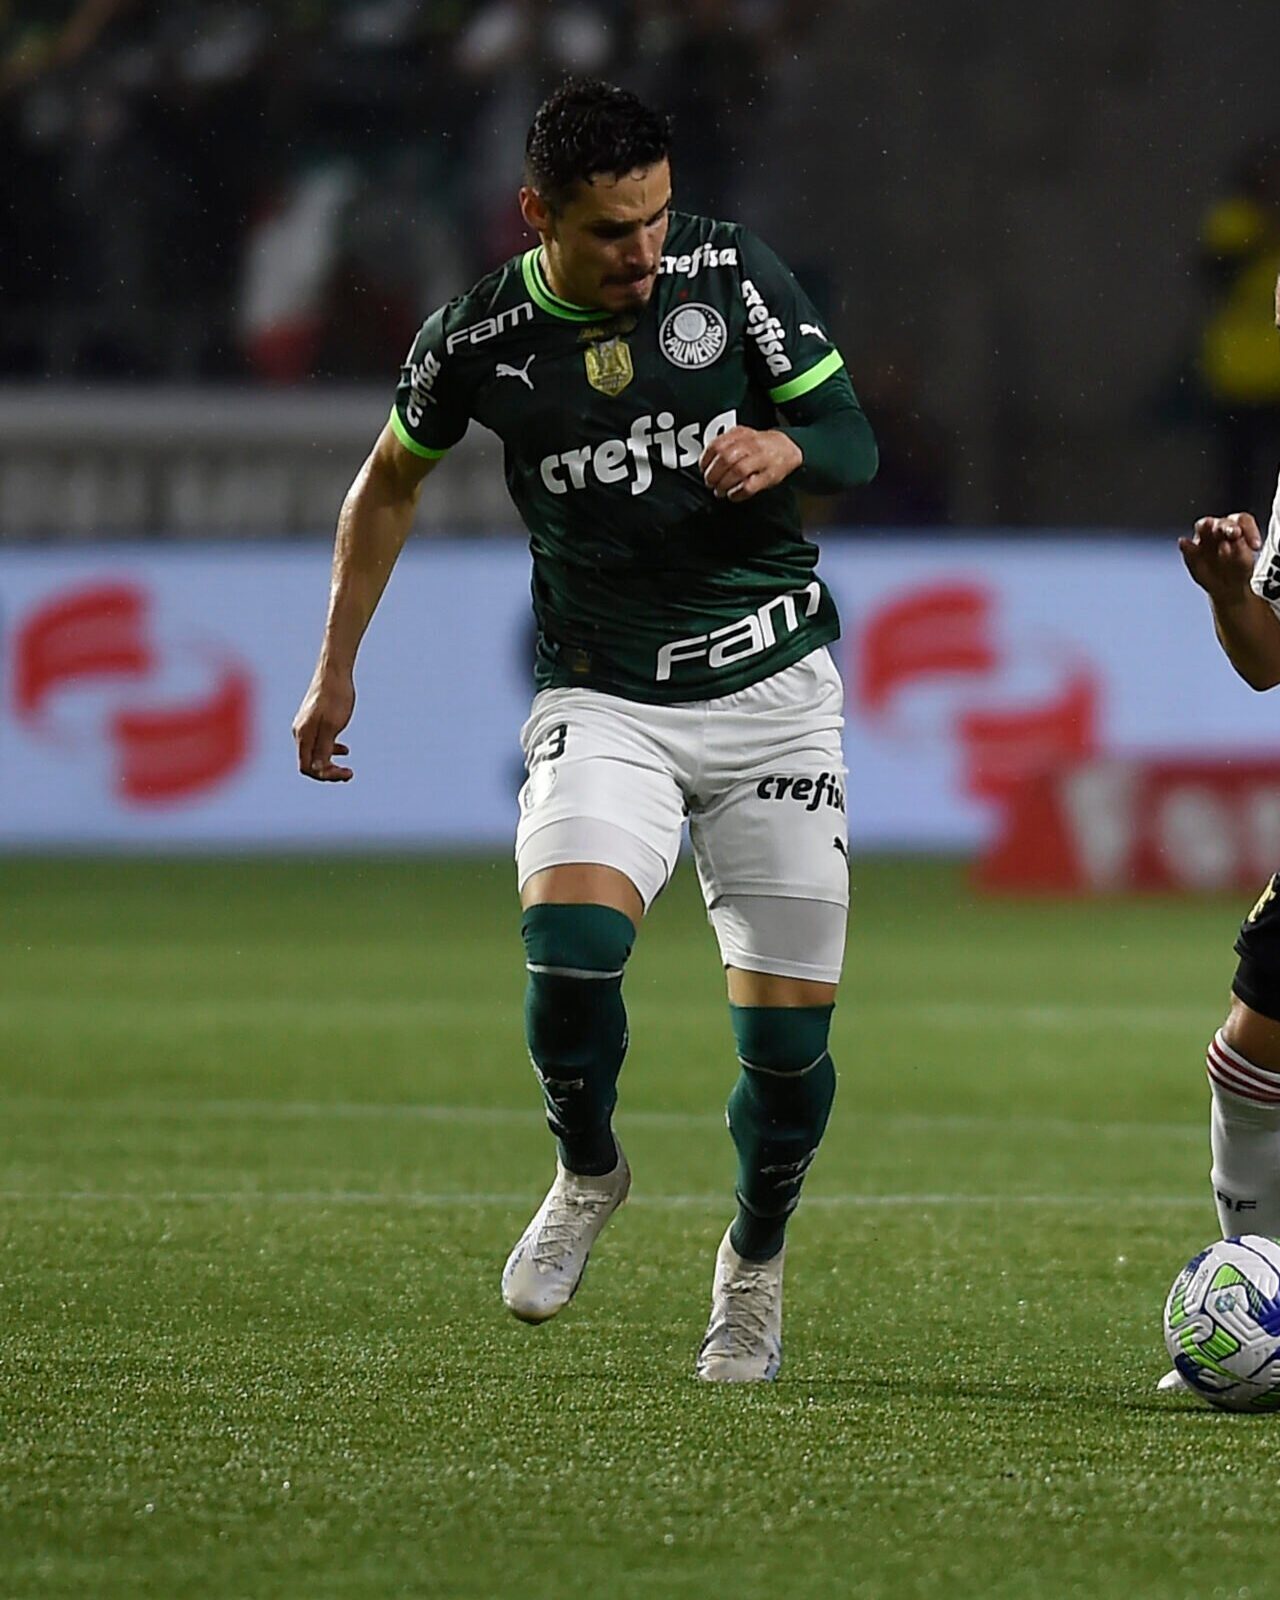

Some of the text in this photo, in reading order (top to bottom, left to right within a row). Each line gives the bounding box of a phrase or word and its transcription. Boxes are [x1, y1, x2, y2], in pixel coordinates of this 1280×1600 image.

[656, 243, 738, 279] crefisa
[446, 301, 534, 355] Fam
[664, 324, 723, 365] PALMEIRAS
[741, 279, 793, 378] crefisa
[655, 581, 821, 681] Fam
[756, 771, 846, 814] crefis
